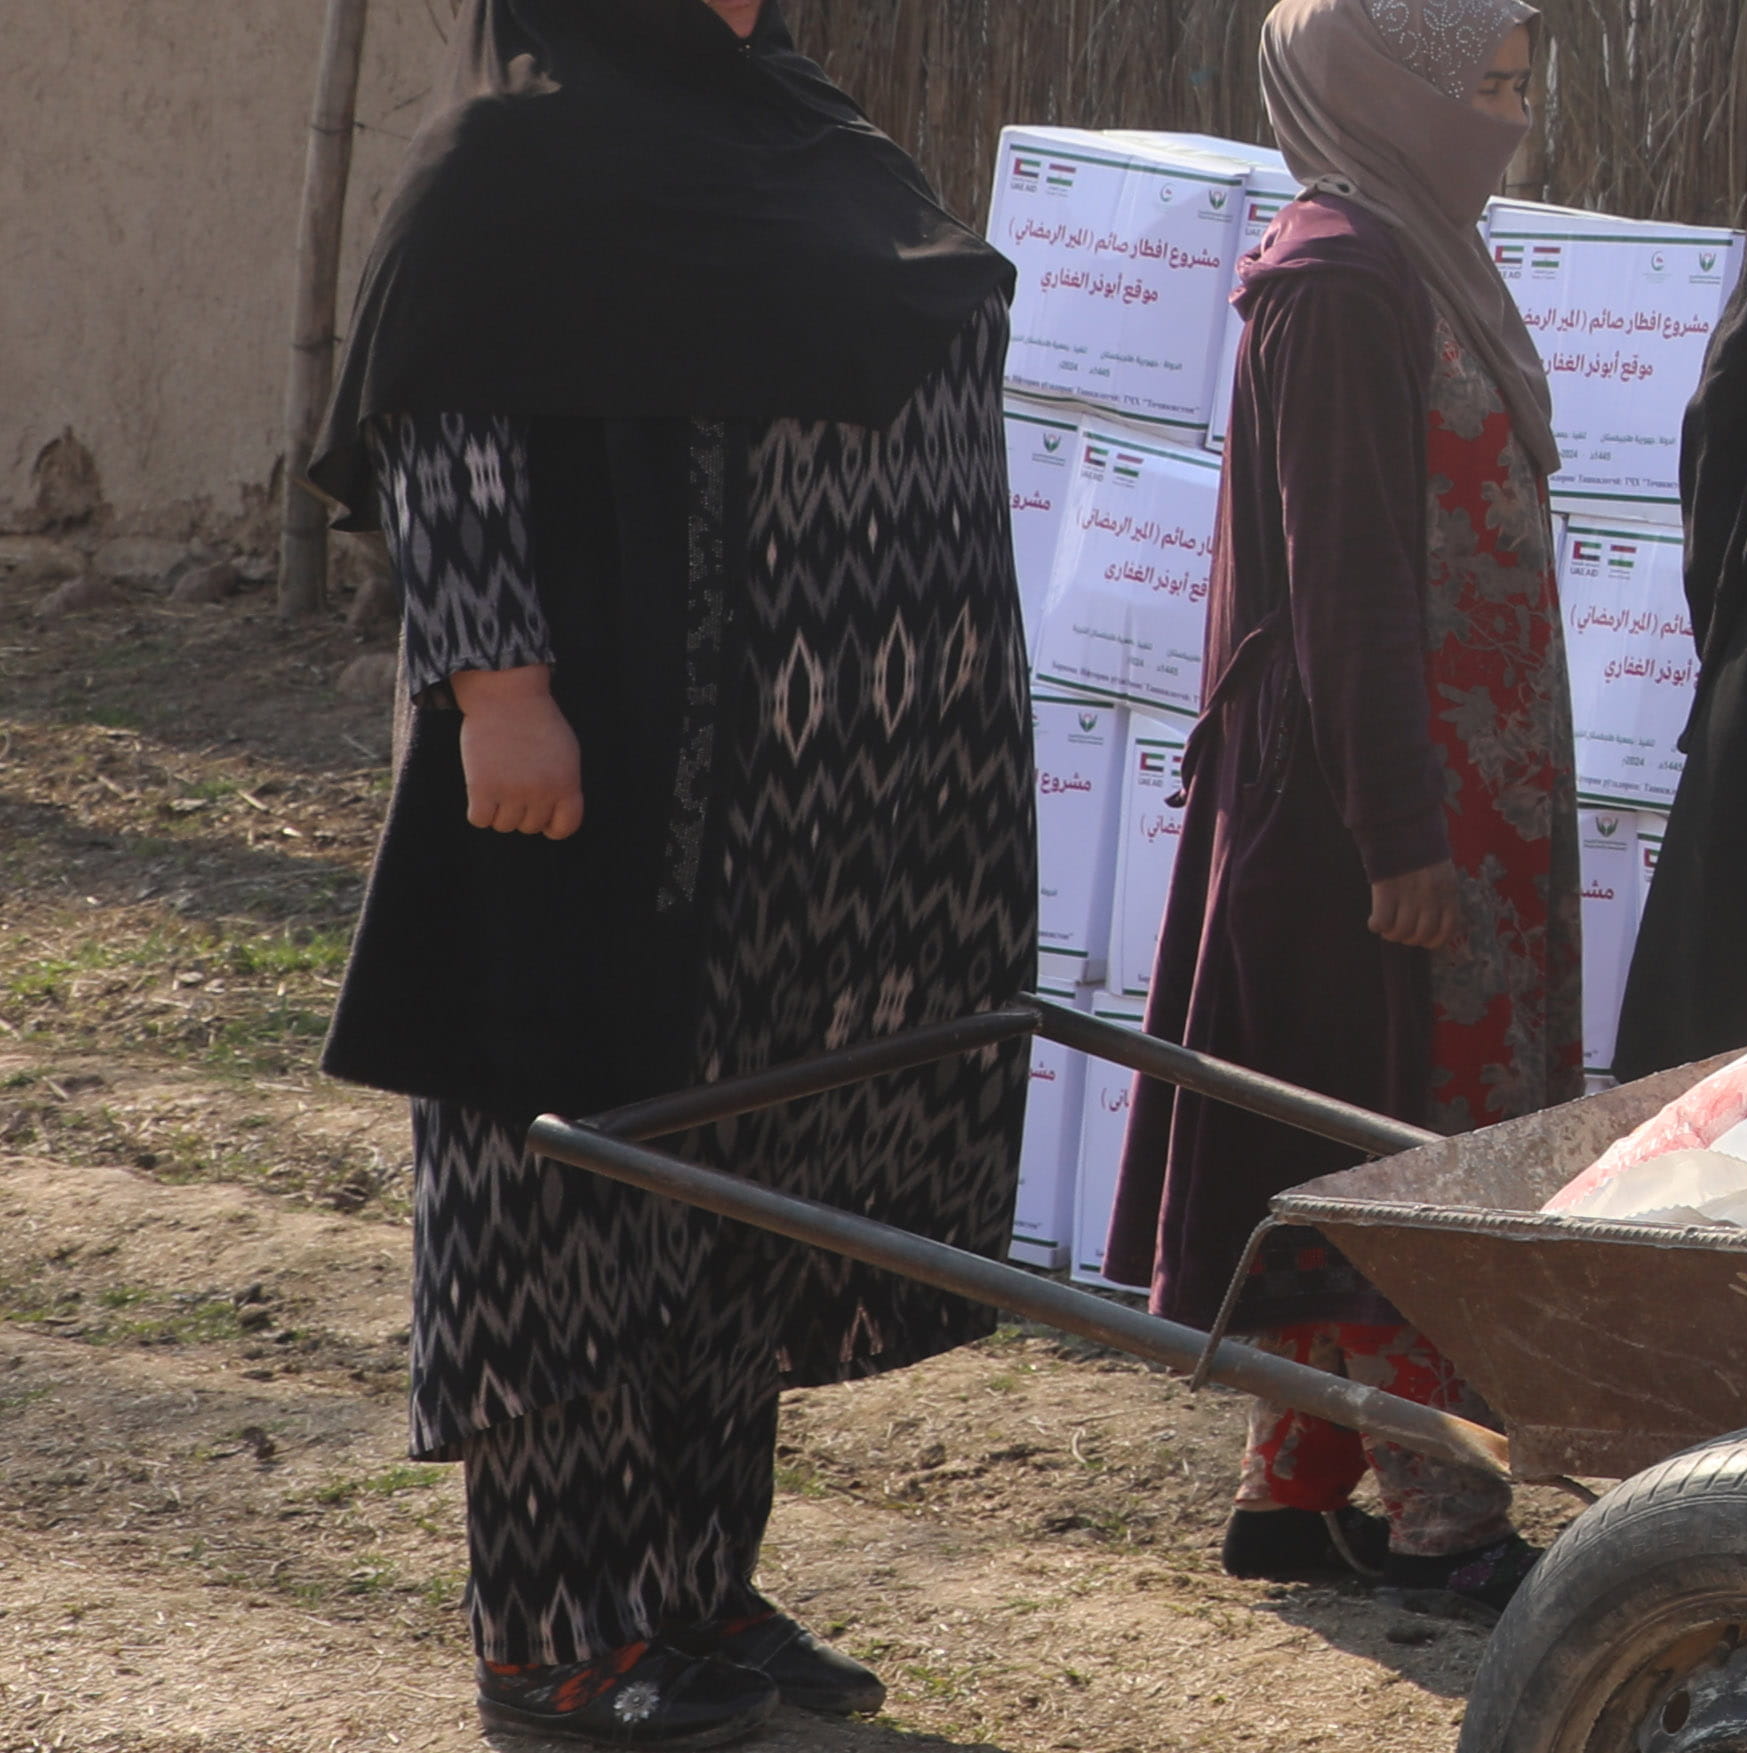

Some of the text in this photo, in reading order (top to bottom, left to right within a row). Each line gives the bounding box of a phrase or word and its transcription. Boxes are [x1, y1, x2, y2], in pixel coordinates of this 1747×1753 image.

[1095, 232, 1128, 254] صائم
[1130, 239, 1168, 258] افطار
[1169, 247, 1220, 268] مشروع
[1041, 269, 1158, 304] موقع أبوذر الغفاري
[1589, 310, 1624, 333] صائم
[1626, 311, 1661, 334] افطار
[1663, 316, 1709, 339] مشروع
[1544, 351, 1653, 382] موقع أبوذر الغفار
[1156, 527, 1196, 549] صائم
[1605, 656, 1692, 686] أبوذر الغفاري
[1041, 773, 1091, 794] مشروع
